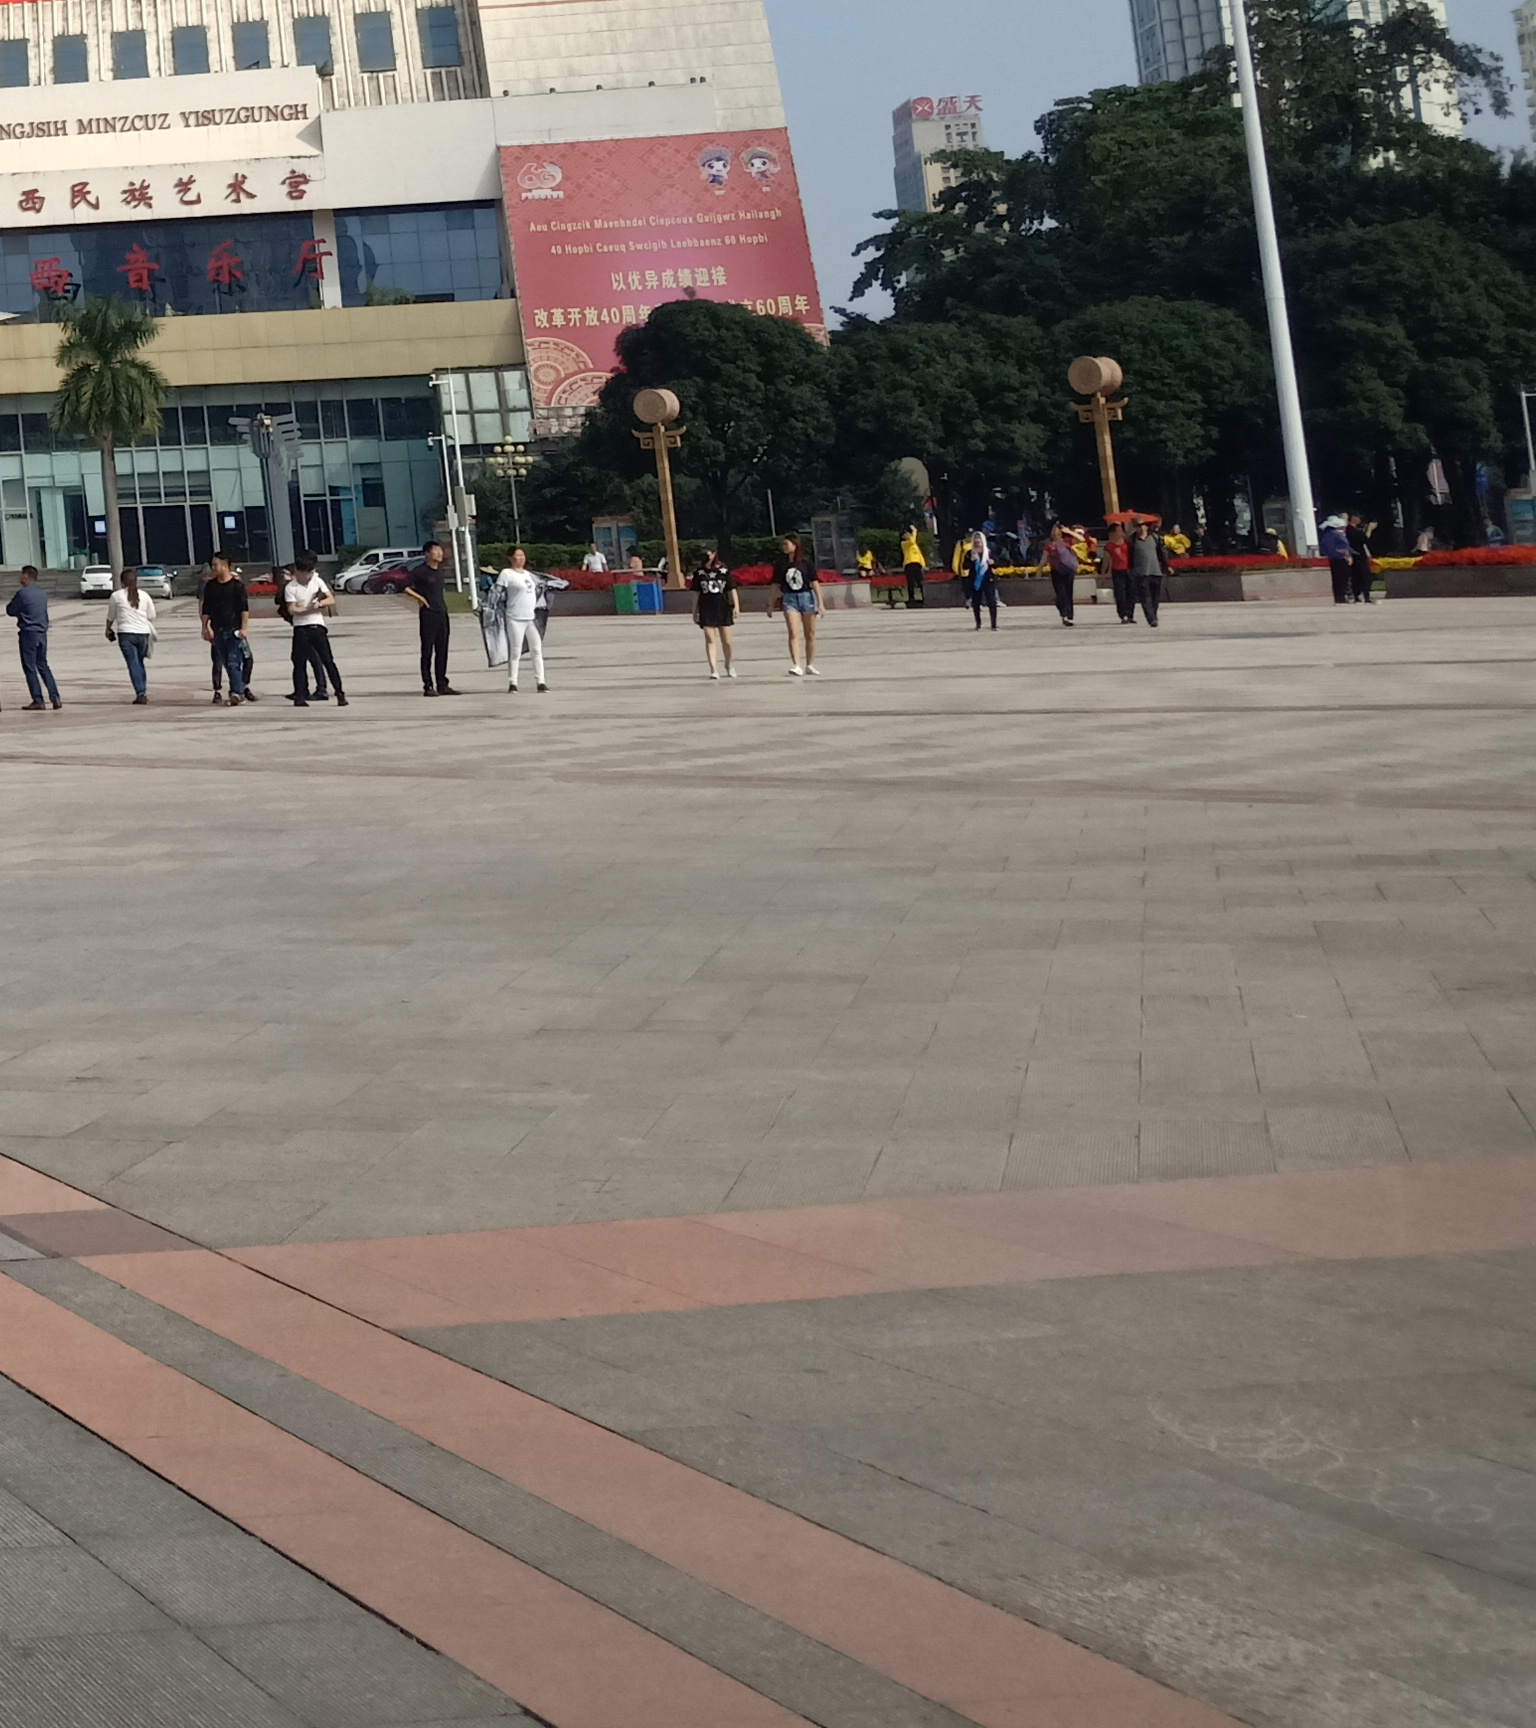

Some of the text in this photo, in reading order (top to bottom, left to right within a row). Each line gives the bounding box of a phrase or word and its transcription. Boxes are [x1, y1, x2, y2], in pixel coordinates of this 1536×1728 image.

[77, 113, 171, 136] MINZCUZ
[180, 103, 309, 129] YISUZGUNGH
[611, 265, 728, 292] 以优异成绩迎接
